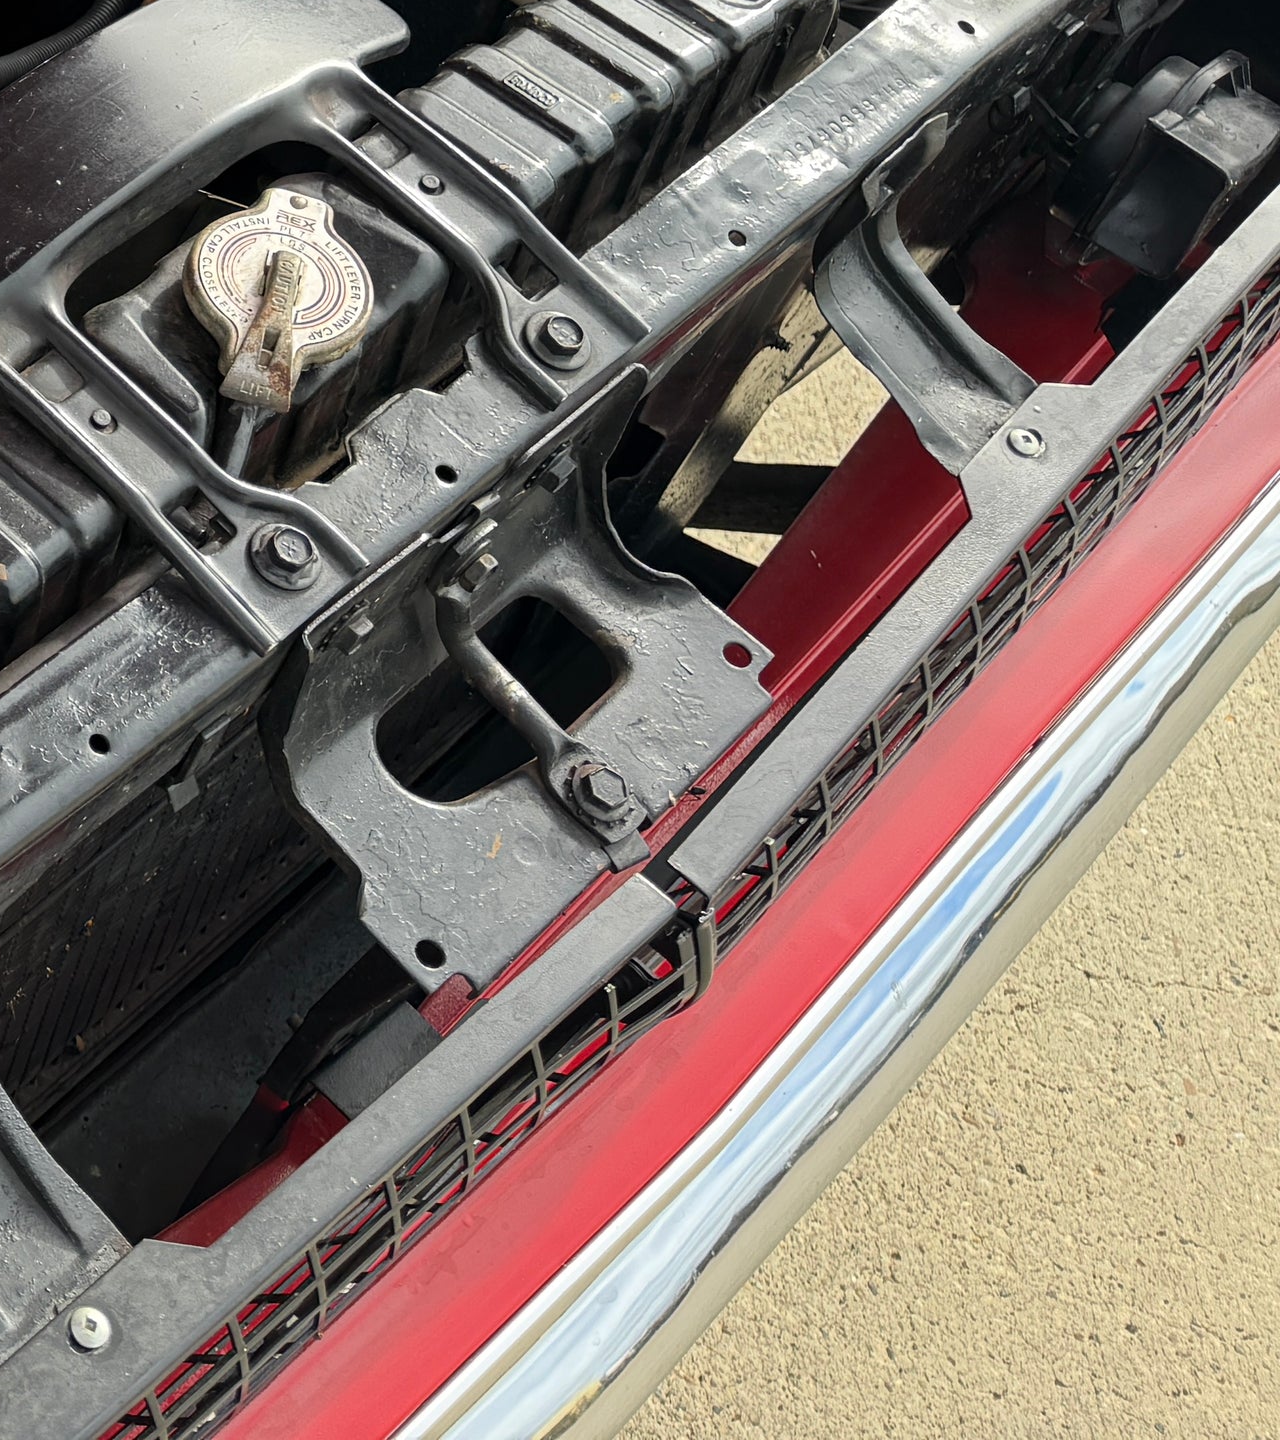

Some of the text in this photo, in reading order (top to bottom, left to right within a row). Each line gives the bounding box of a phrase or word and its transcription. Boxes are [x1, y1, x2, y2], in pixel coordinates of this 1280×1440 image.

[220, 216, 270, 237] INSTALL
[276, 211, 316, 233] REX
[208, 231, 224, 254] CAP
[324, 241, 349, 266] LIFT
[202, 256, 219, 293] CLOSE
[336, 303, 359, 331] TURN
[308, 328, 333, 342] CAP
[239, 379, 273, 402] LIFT
